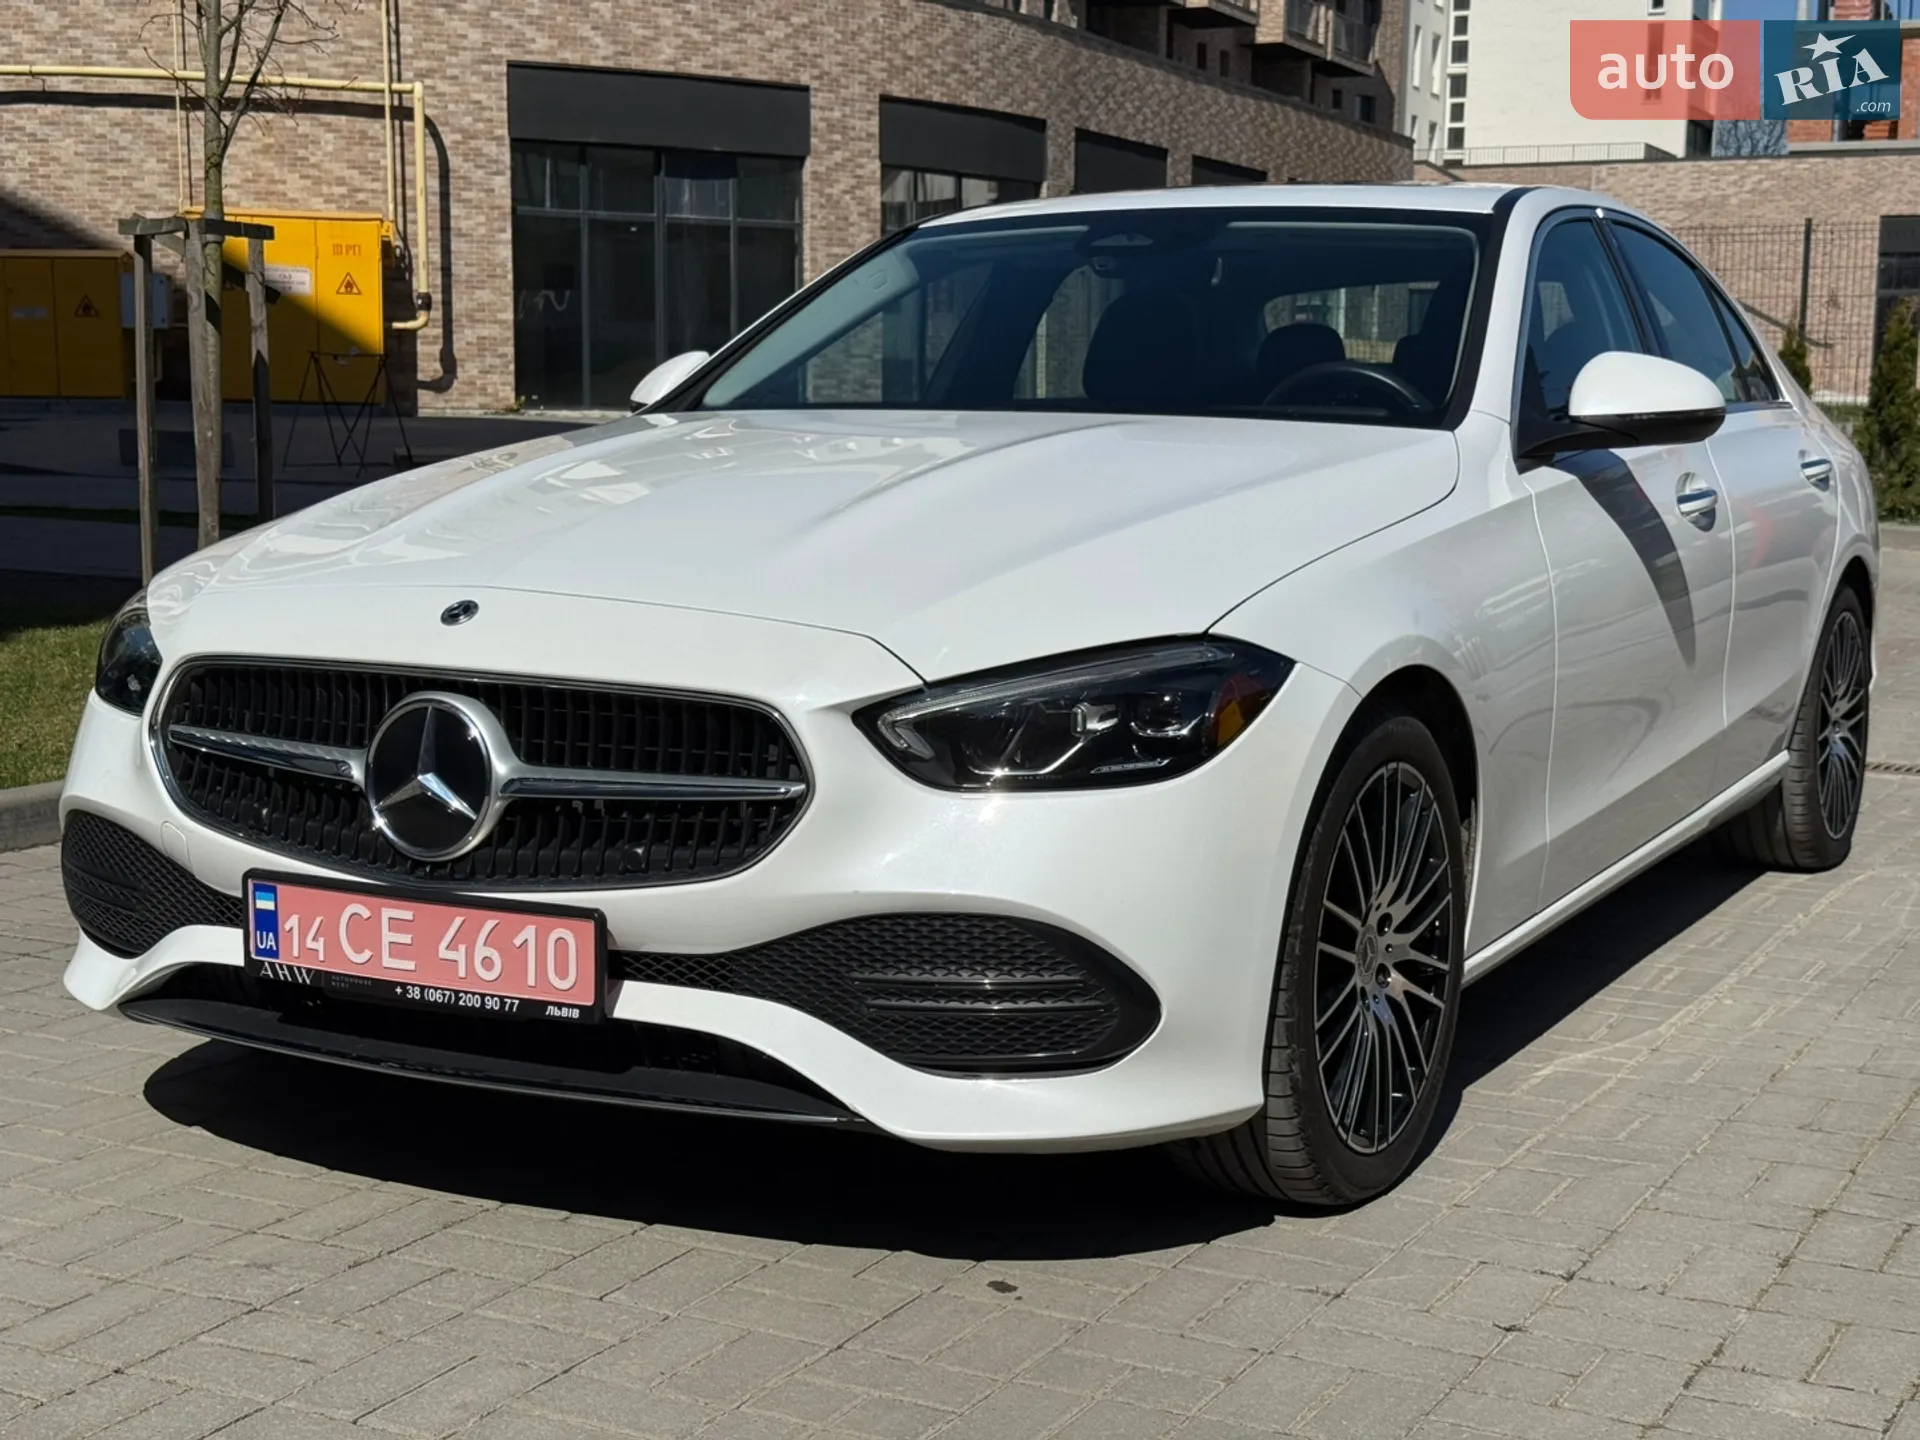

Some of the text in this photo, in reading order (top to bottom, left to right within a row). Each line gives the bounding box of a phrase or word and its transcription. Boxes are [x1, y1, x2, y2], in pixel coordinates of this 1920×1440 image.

[256, 930, 277, 951] UA
[283, 903, 579, 992] 14 CE 4610
[260, 962, 316, 986] AHW
[406, 985, 421, 1000] 38
[424, 987, 455, 1004] (067)
[458, 992, 481, 1008] 200
[484, 996, 500, 1011] 90
[503, 998, 519, 1013] 77
